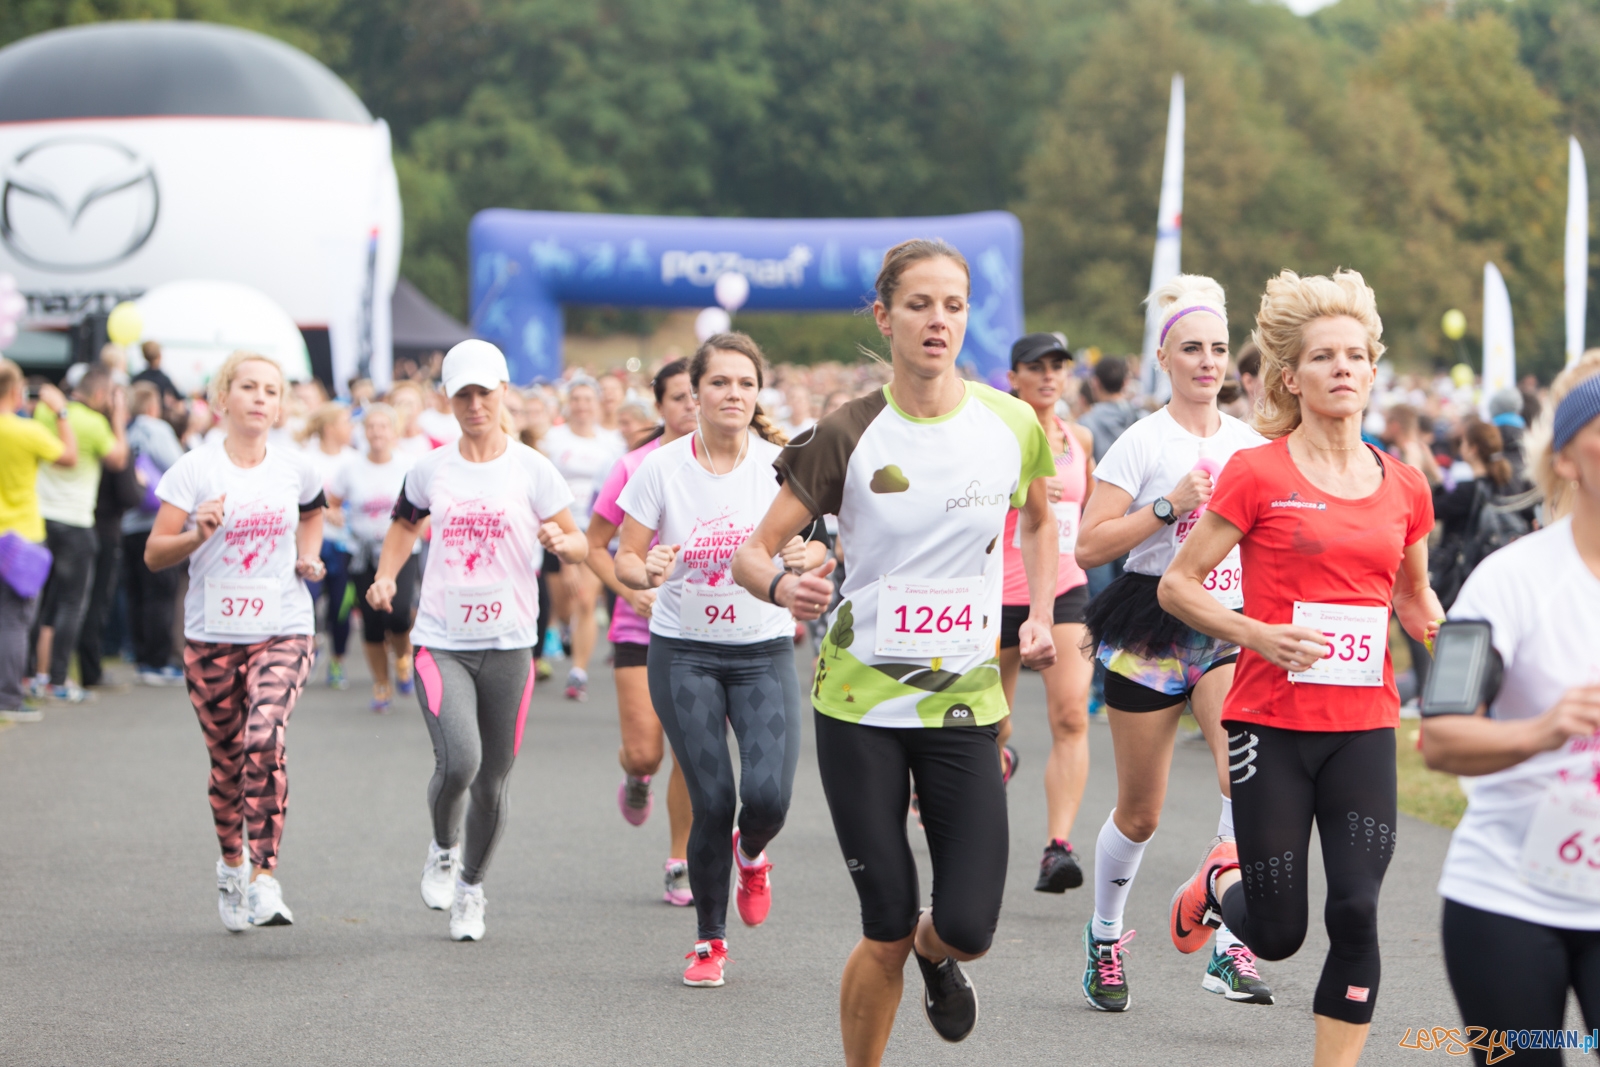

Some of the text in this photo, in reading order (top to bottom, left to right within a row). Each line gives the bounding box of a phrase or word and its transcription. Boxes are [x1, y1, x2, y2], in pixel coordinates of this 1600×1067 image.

[946, 489, 1004, 512] parkrun
[450, 516, 500, 527] zawsze
[687, 561, 709, 569] 2016
[1202, 567, 1241, 591] 339
[221, 596, 264, 617] 379
[460, 601, 502, 623] 739
[704, 604, 737, 625] 94
[894, 604, 973, 634] 1264
[1321, 631, 1371, 663] 535
